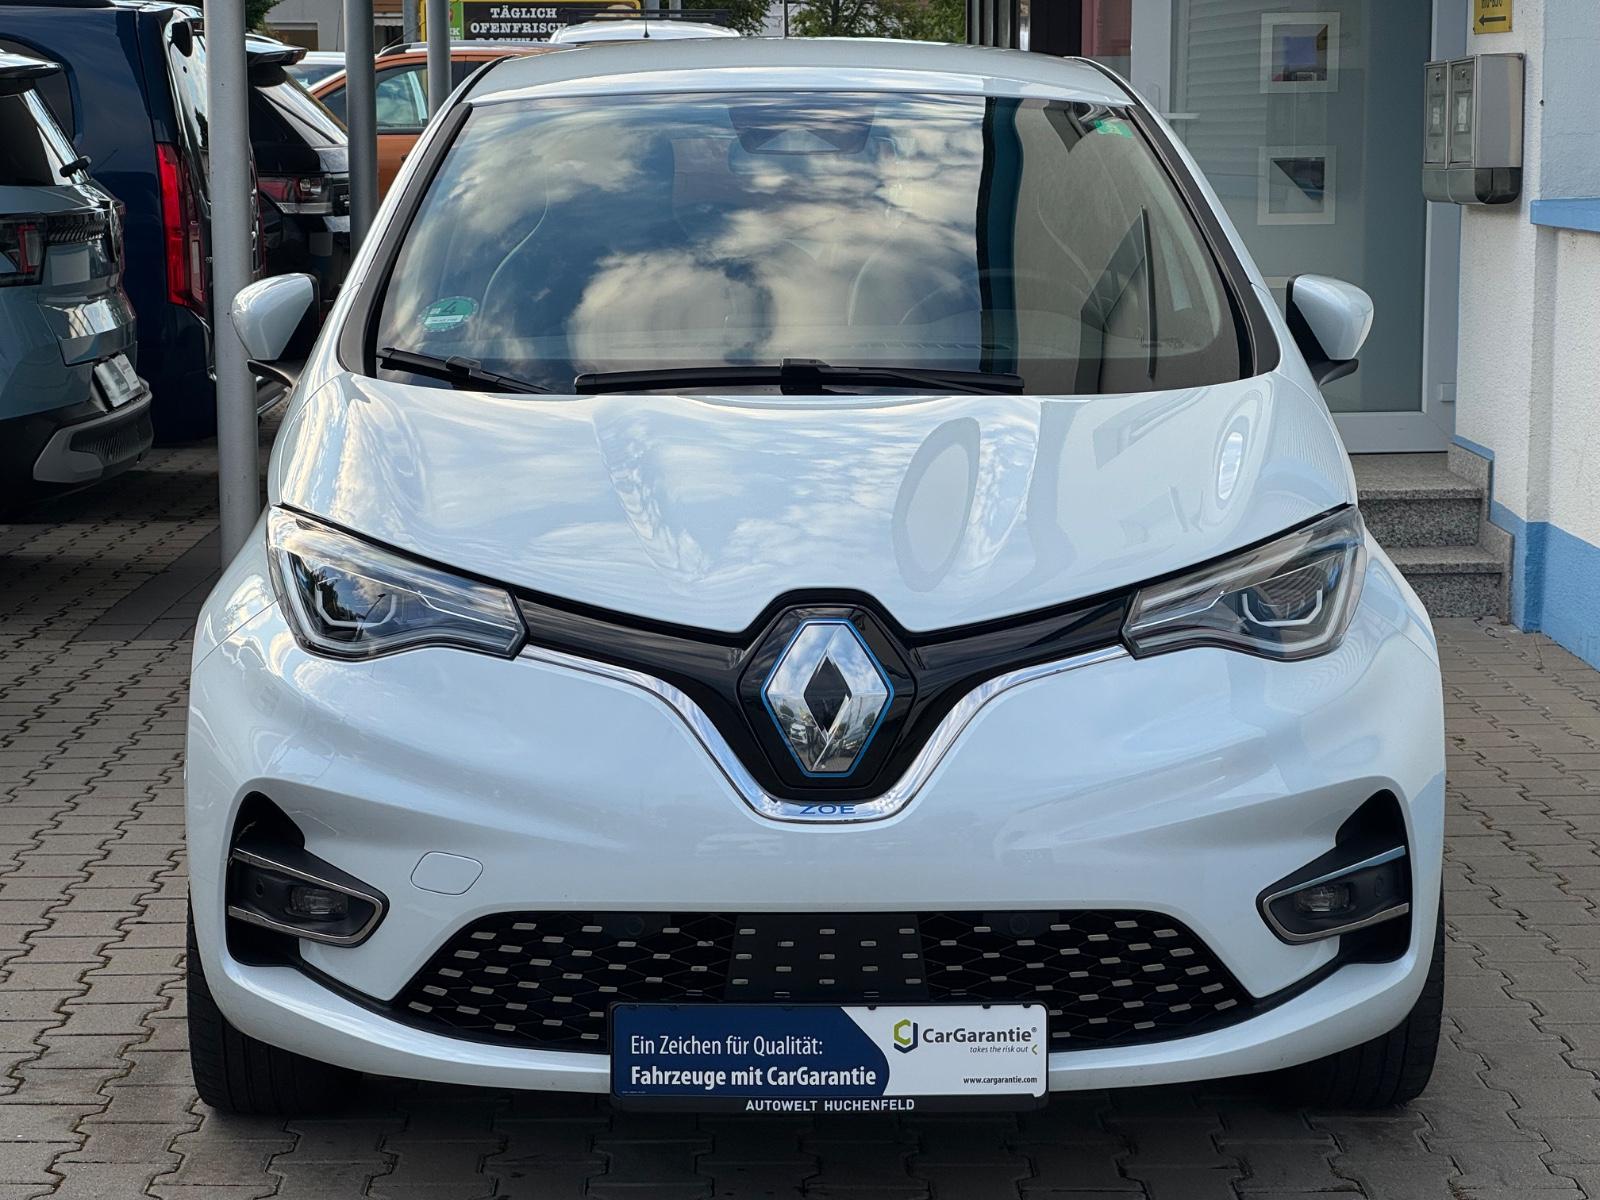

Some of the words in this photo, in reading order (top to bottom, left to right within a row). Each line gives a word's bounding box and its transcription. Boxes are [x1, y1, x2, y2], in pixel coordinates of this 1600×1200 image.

[490, 5, 558, 18] TÄGLICH
[631, 1035, 655, 1055] Ein
[659, 1035, 721, 1055] Zeichen
[726, 1035, 750, 1055] für
[753, 1035, 823, 1057] Qualität:
[989, 1045, 1001, 1053] the
[1002, 1045, 1015, 1053] risk
[631, 1066, 727, 1090] Fahrzeuge
[731, 1066, 763, 1086] mit
[767, 1066, 876, 1086] CarGarantie
[963, 1075, 1038, 1085] www.cargarantie.com
[745, 1100, 818, 1112] AUTOWELT
[824, 1099, 915, 1111] HUCHENFELD
